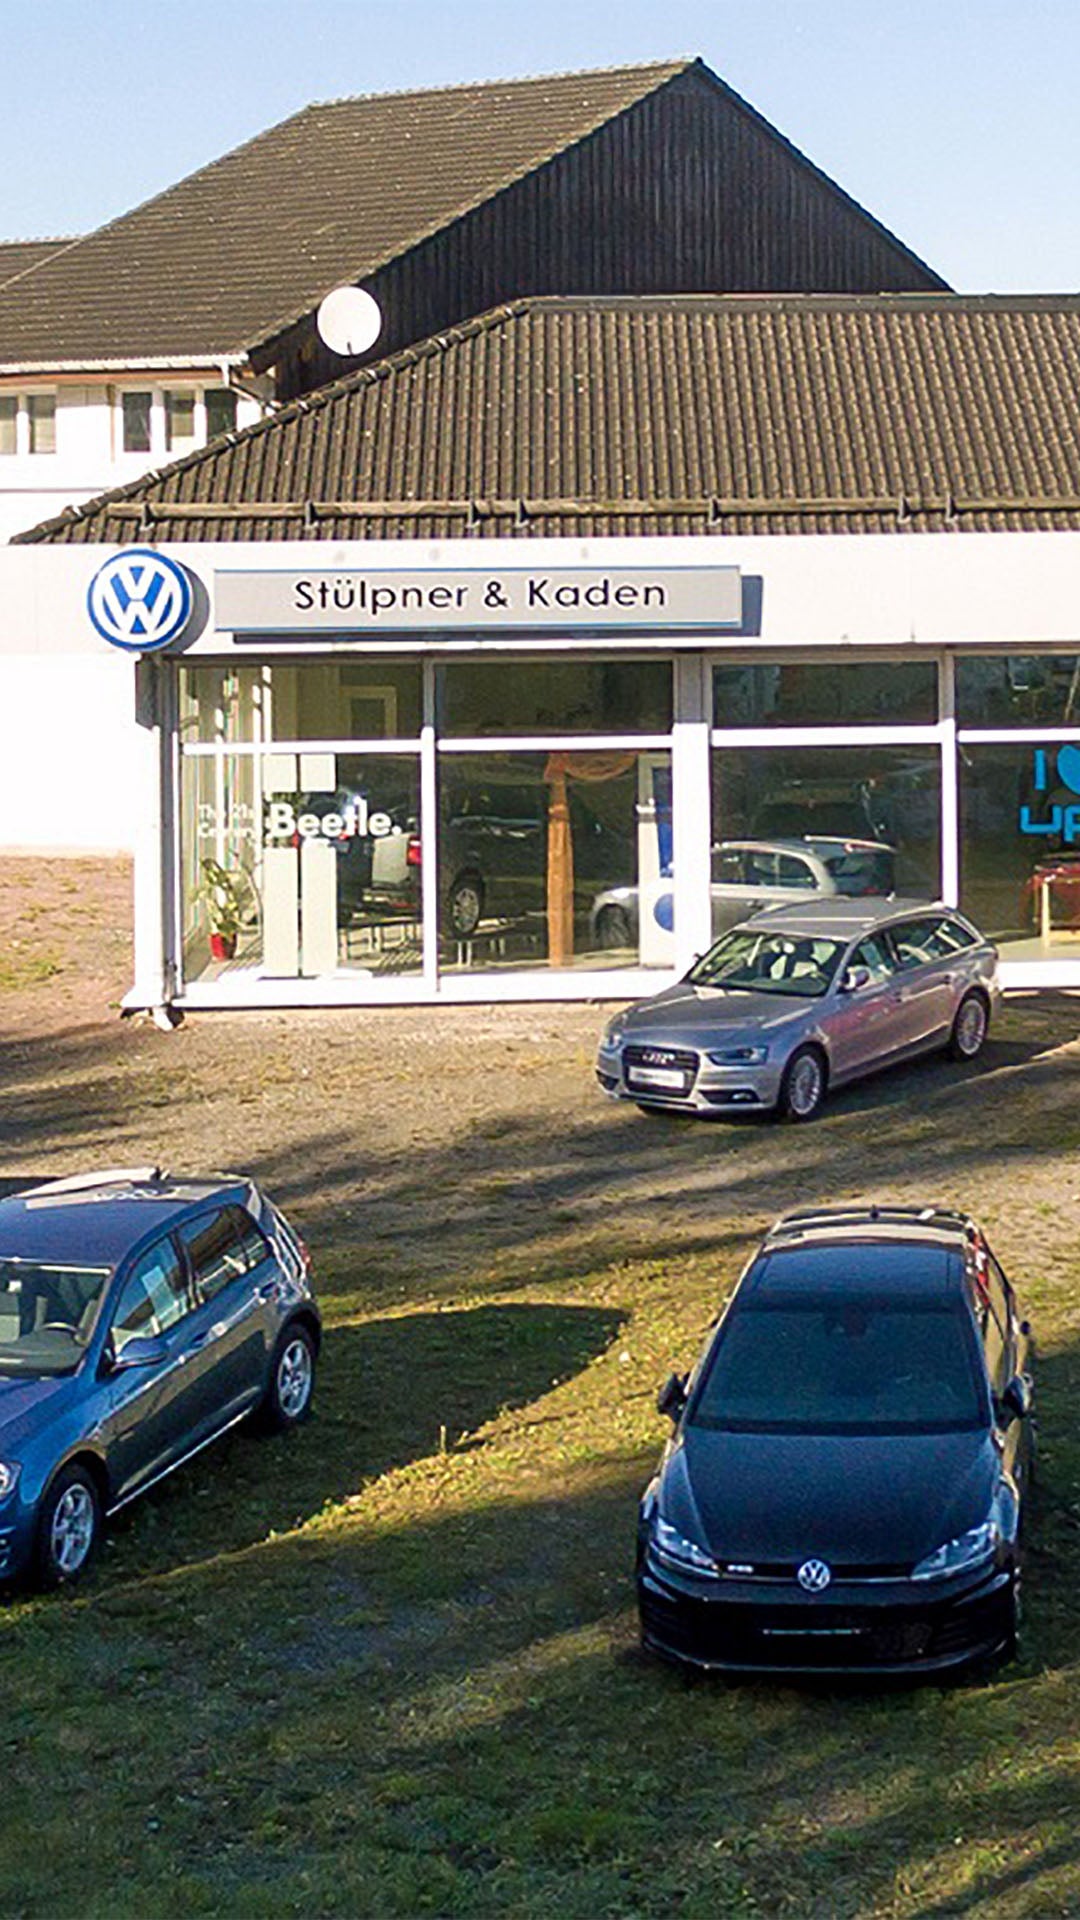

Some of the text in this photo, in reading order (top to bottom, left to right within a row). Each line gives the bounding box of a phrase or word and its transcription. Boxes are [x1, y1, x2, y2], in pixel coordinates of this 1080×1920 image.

[294, 578, 666, 616] Stülpner & Kaden
[1033, 748, 1046, 791] I
[269, 795, 402, 838] Beetle.
